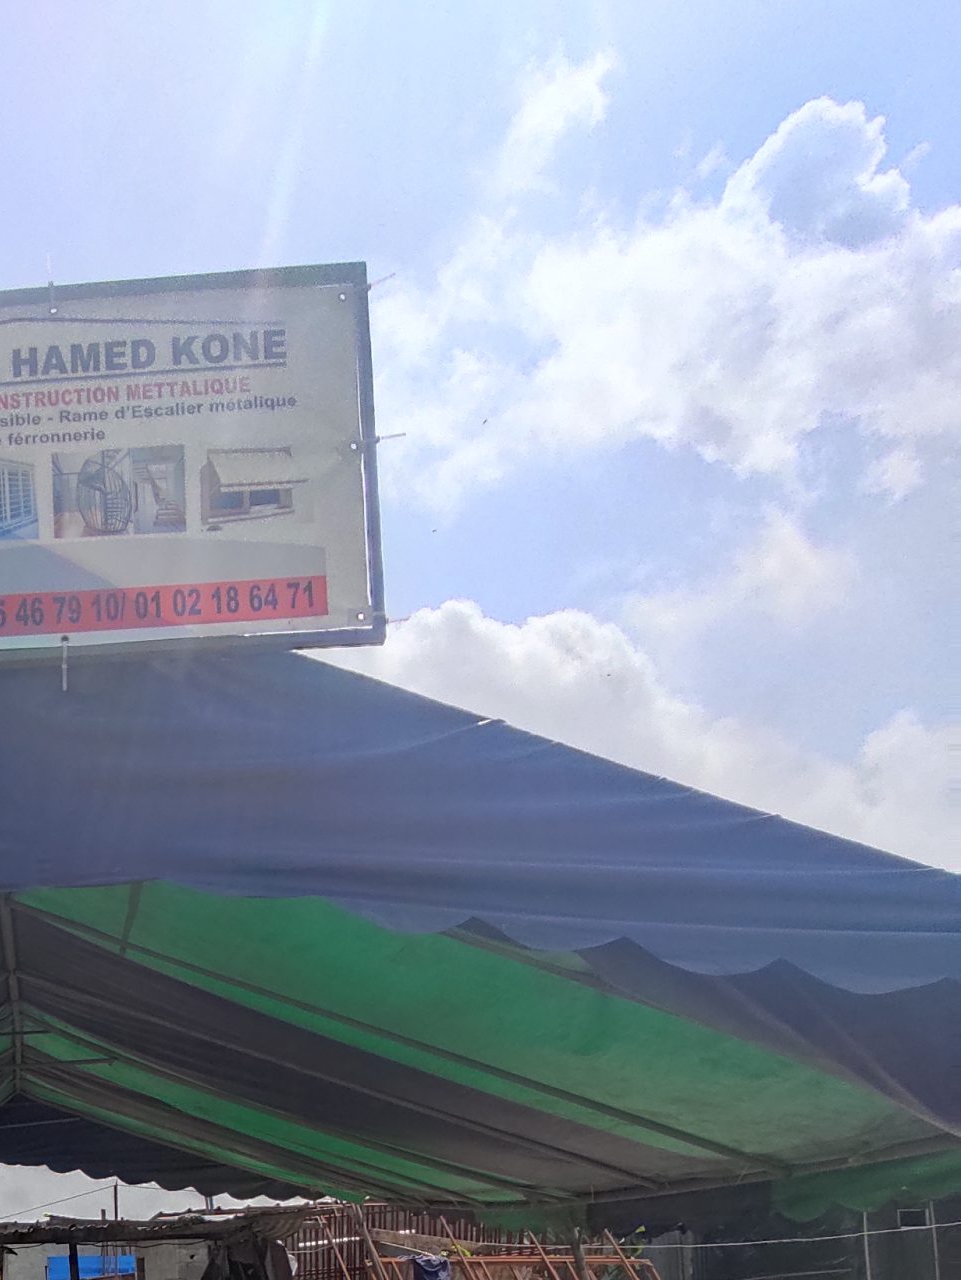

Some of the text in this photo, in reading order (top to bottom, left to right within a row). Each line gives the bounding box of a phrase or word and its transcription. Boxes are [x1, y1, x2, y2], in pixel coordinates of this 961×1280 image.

[11, 339, 156, 378] HAMED
[172, 329, 287, 366] KONE
[126, 376, 251, 402] METTALIQUE
[59, 410, 108, 424] Rame
[114, 401, 203, 420] d'Escalier
[209, 394, 297, 413] métalique
[8, 427, 106, 447] férronnerie
[15, 598, 44, 626] 46
[52, 595, 81, 624] 79
[134, 590, 161, 619] 01
[172, 588, 202, 617] 02
[211, 585, 239, 614] 18
[249, 583, 278, 611] 64
[286, 579, 314, 608] 71
